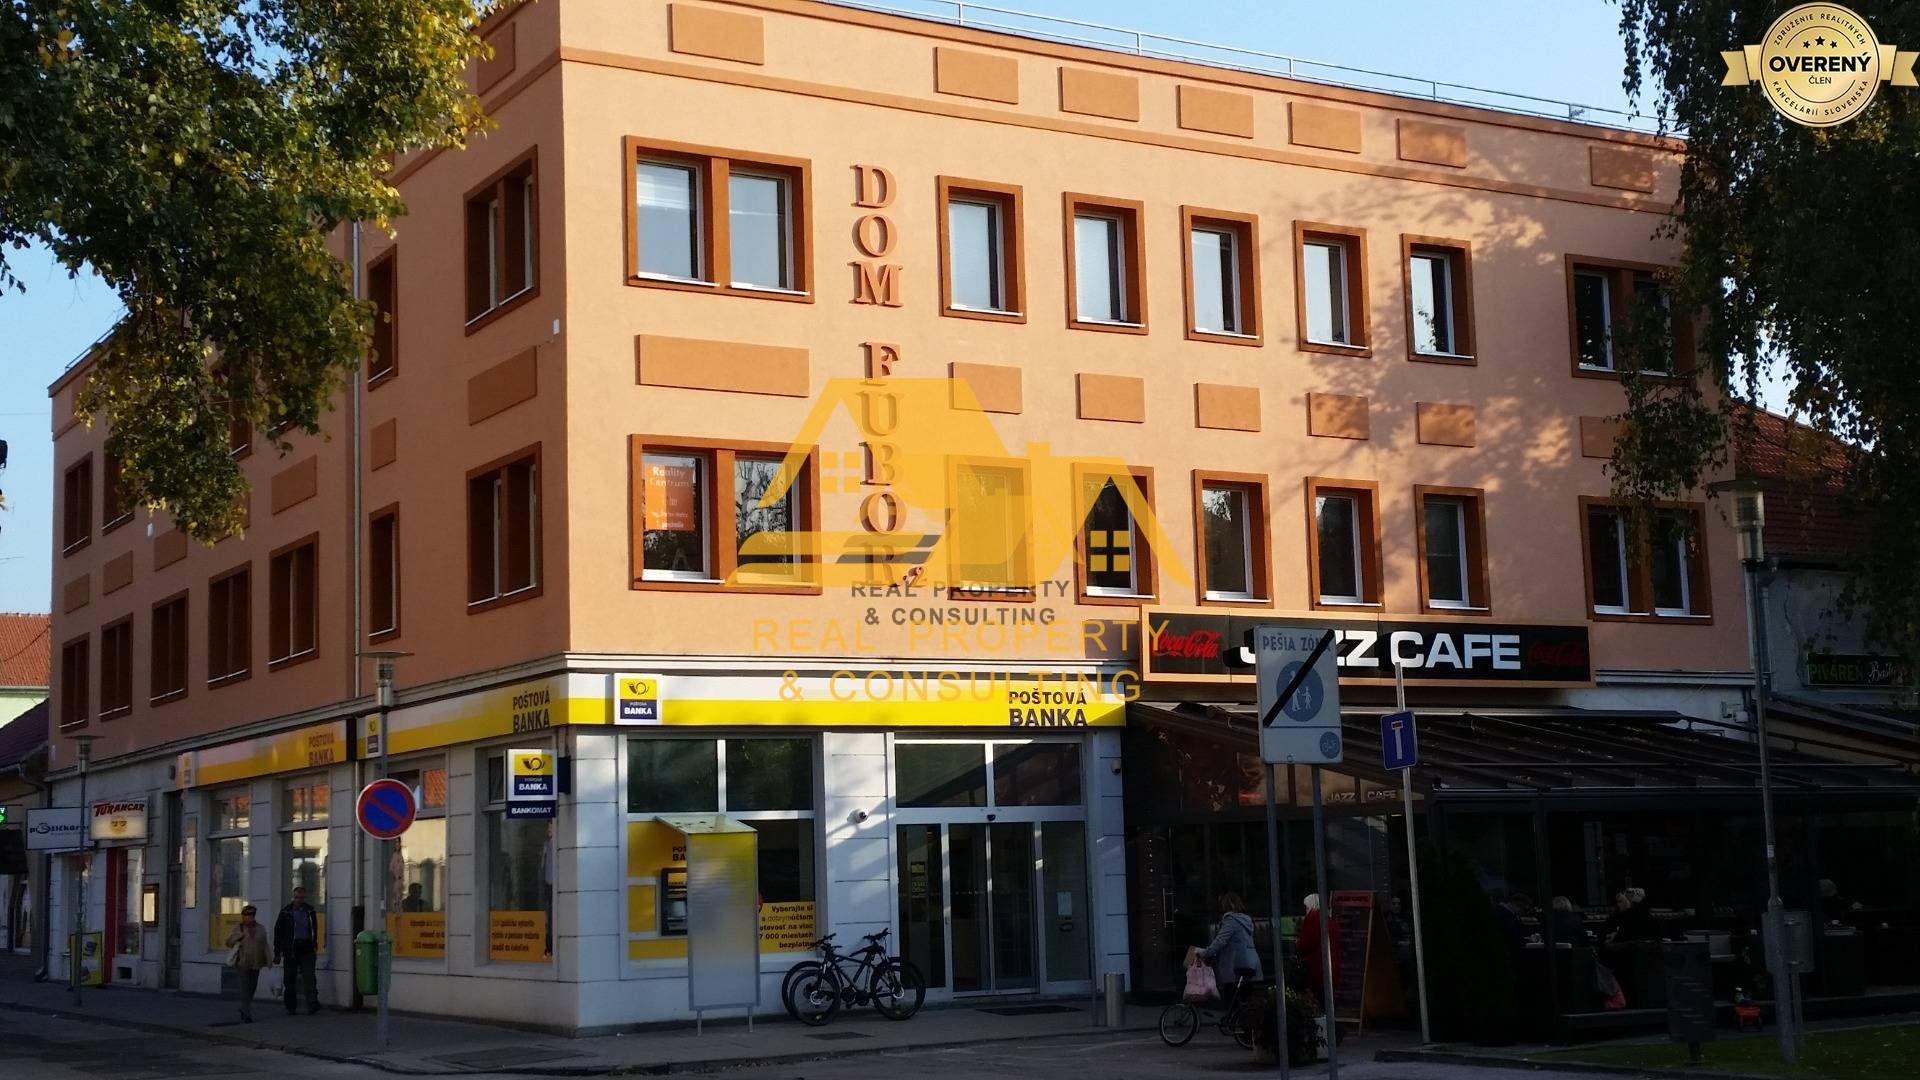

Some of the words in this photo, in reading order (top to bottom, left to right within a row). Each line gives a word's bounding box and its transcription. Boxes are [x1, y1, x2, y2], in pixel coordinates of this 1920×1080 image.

[847, 163, 904, 309] DOM
[1263, 632, 1296, 652] PEŠIA
[1390, 630, 1521, 670] CAFE
[512, 687, 550, 710] POŠTOVÁ
[1008, 688, 1088, 705] POŠTOVÁ
[624, 707, 652, 715] BANKA
[1008, 708, 1088, 727] BANKA
[512, 708, 550, 733] BANKA
[518, 783, 547, 791] BANKA
[1367, 789, 1397, 799] CAFE
[93, 803, 145, 817] TURANCAR
[511, 807, 552, 815] BANKOMAT
